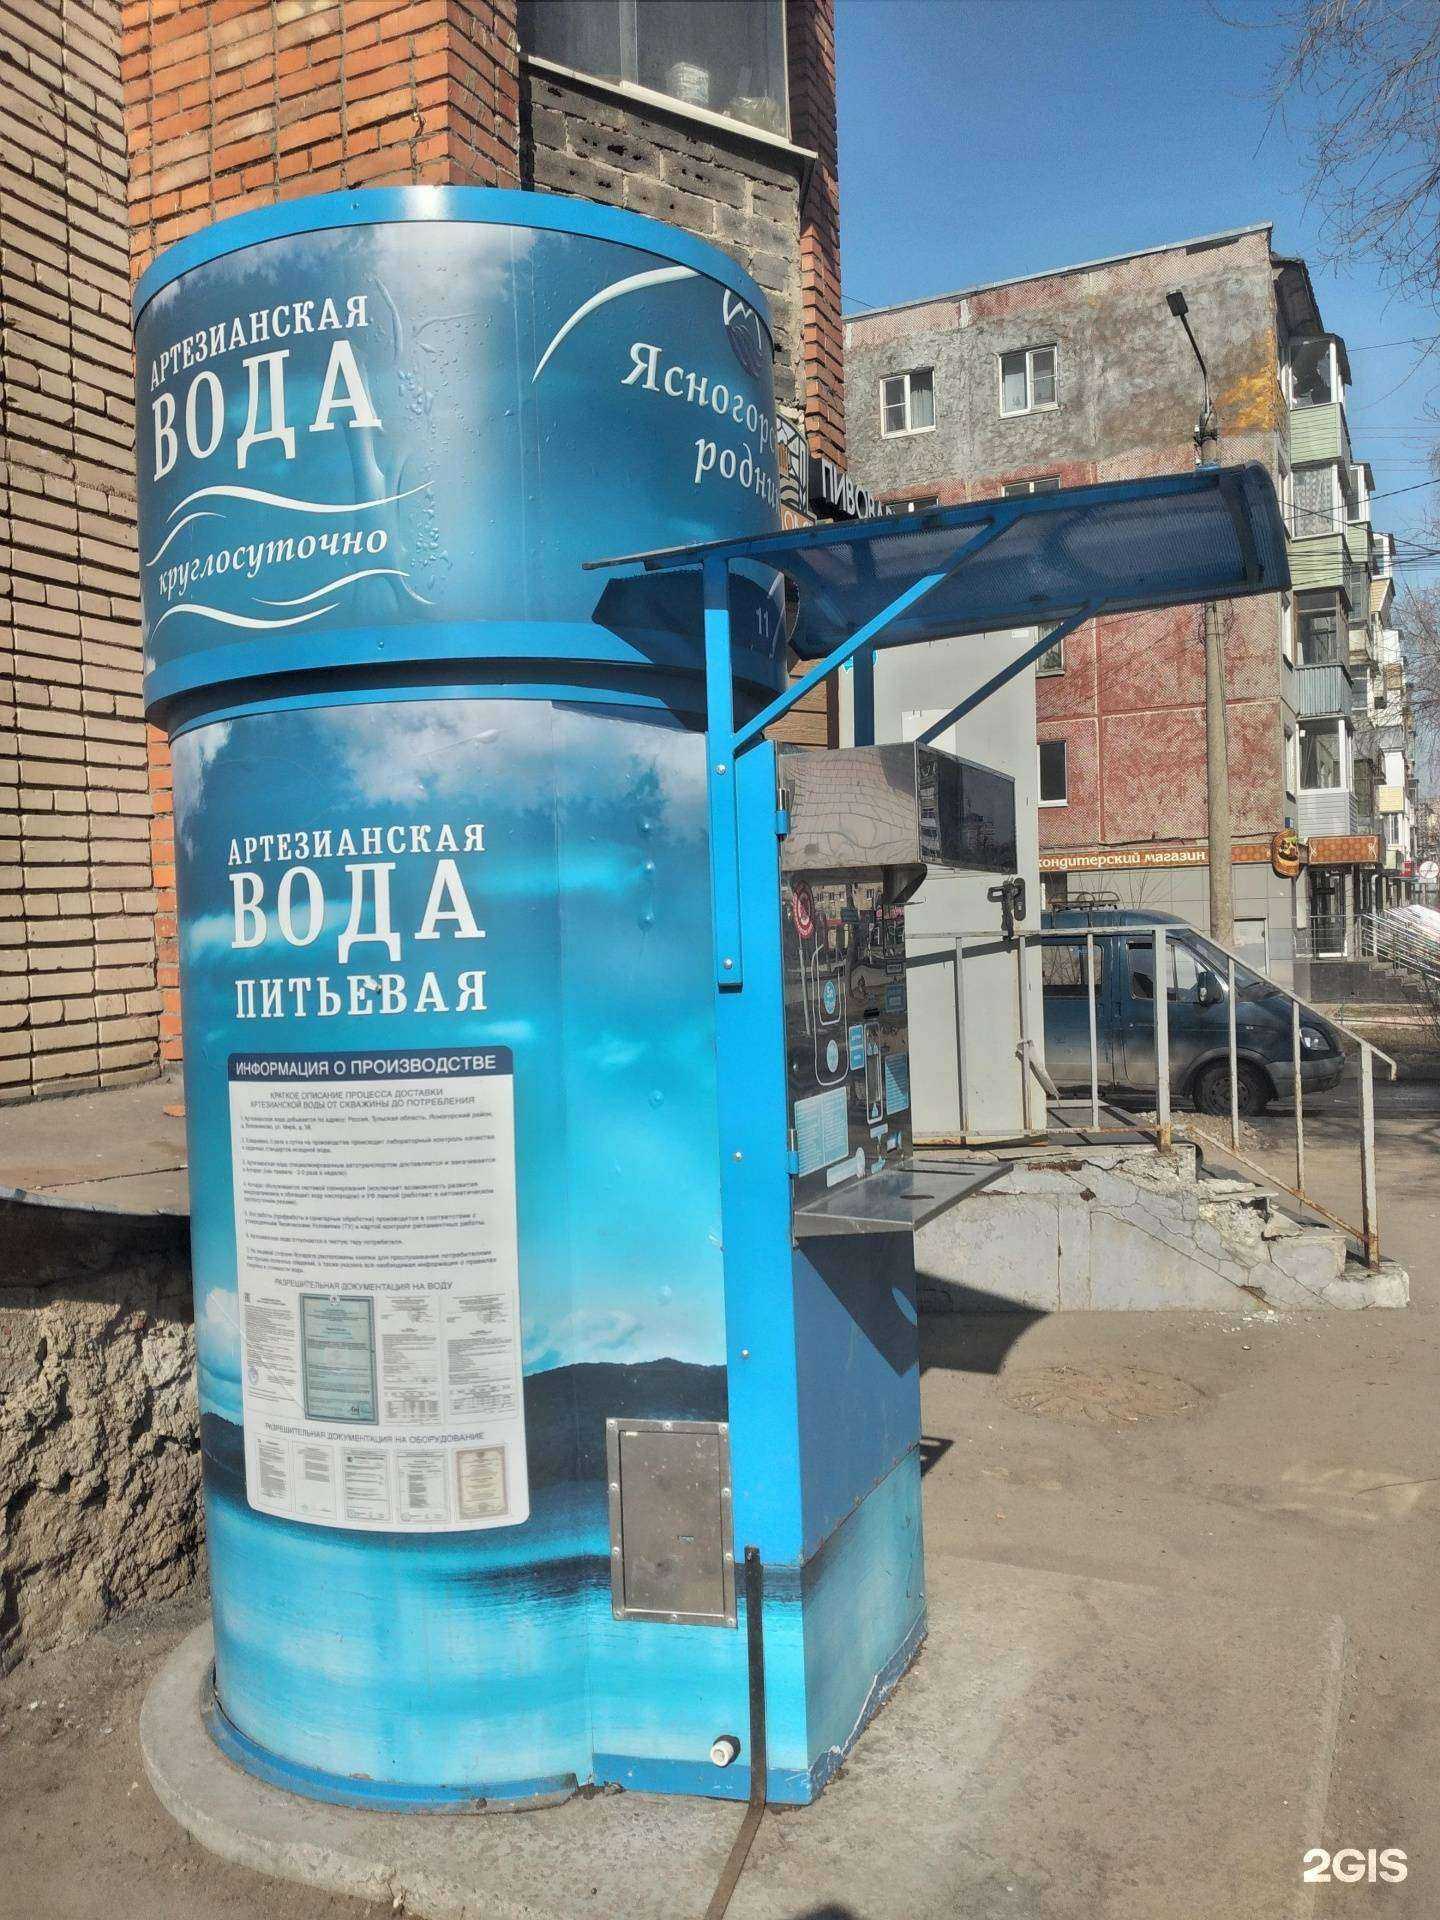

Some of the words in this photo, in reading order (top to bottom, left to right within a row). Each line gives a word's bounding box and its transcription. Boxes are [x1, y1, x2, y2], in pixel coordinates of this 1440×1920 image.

[150, 295, 369, 391] АРТЕЗИАНСКАЯ
[151, 339, 382, 482] ВОДА
[157, 528, 388, 602] круглосуточно
[227, 823, 486, 866] АРТЕЗИАНСКАЯ
[1144, 850, 1206, 863] магазин
[228, 858, 487, 964] ВОДА
[235, 970, 488, 1019] ПИТЬЕВАЯ
[236, 1060, 329, 1078] ИНФОРМАЦИЯ
[333, 1060, 346, 1075] О
[351, 1054, 497, 1074] ПРОИЗВОДСТВЕ
[270, 1091, 300, 1100] КРАТКОЕ
[301, 1091, 343, 1100] ОПИСАНИЕ
[345, 1090, 393, 1099] ПРОЦЕССА
[394, 1088, 443, 1098] ДОСТАВКИ
[303, 1101, 326, 1110] ВОДЫ
[327, 1101, 338, 1109] ОТ
[339, 1099, 389, 1109] СКВАЖИНЫ
[391, 1099, 405, 1108] ДО
[406, 1096, 475, 1107] ПОТРЕБЛЕНИЯ
[341, 1281, 411, 1292] ДОКУМЕНТАЦИЯ
[412, 1282, 425, 1291] НА
[427, 1281, 453, 1292] ВОДУ
[395, 1435, 407, 1444] НА
[408, 1432, 485, 1445] ОБОРУДОВАНИЕ
